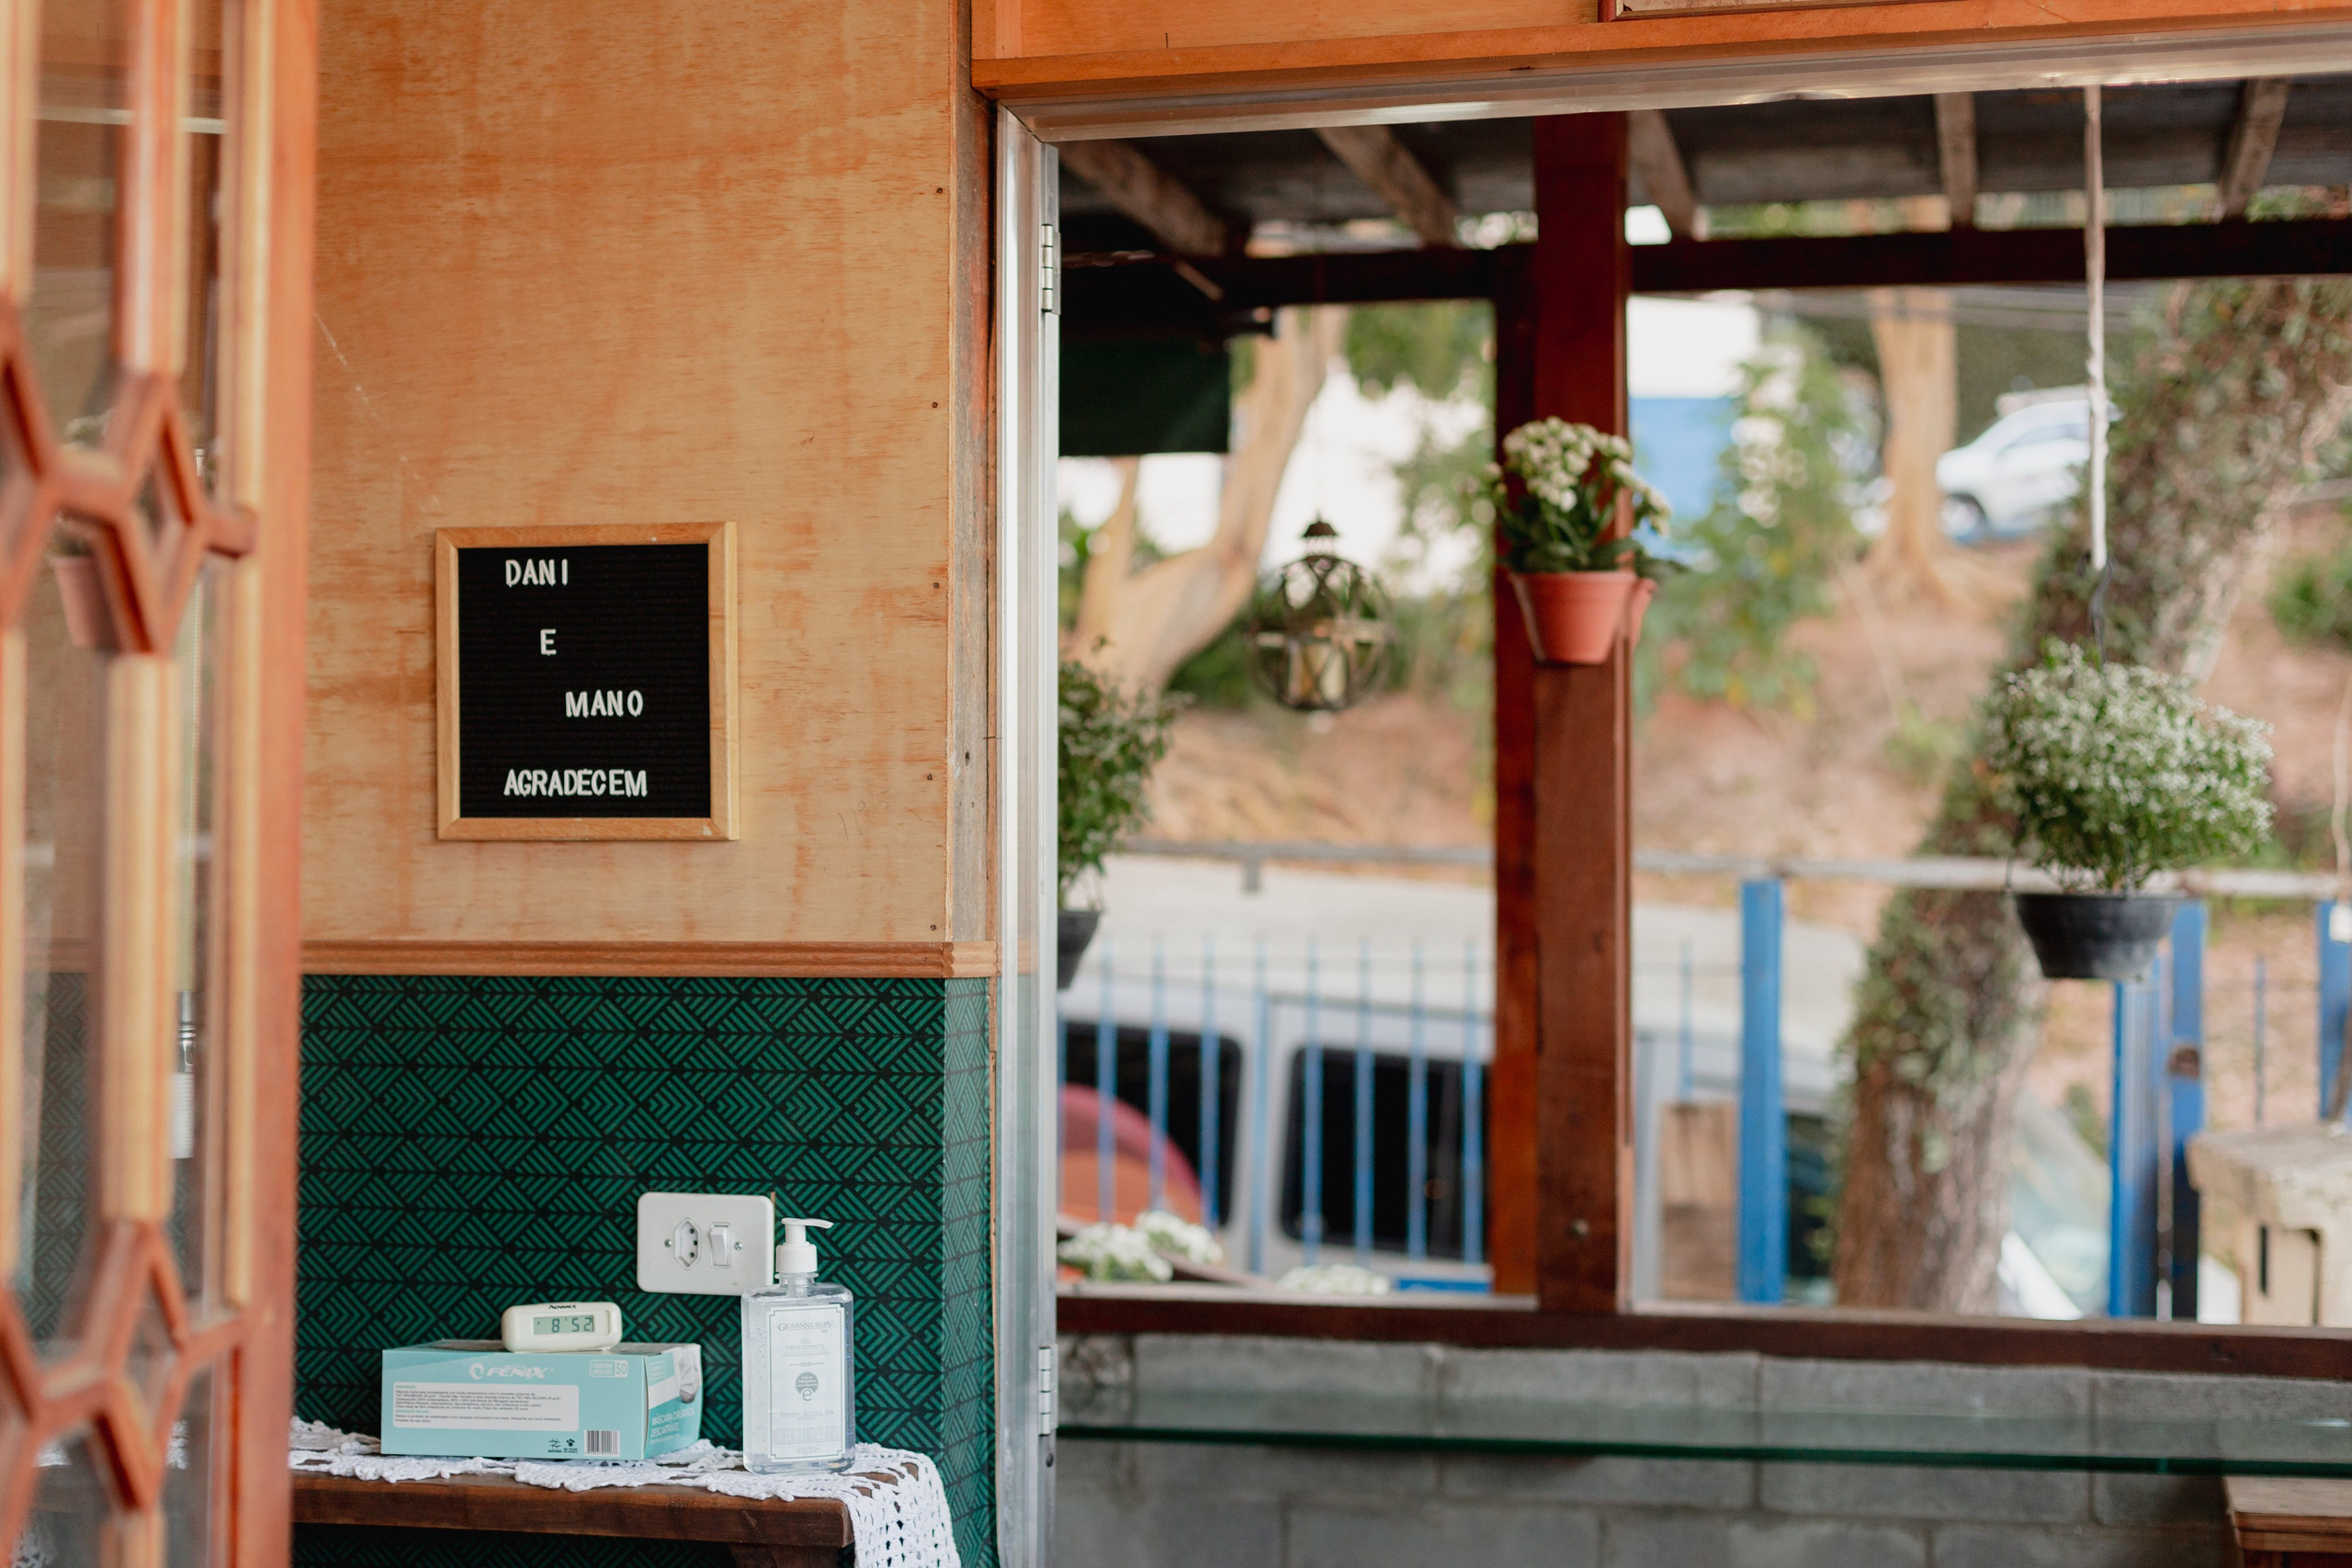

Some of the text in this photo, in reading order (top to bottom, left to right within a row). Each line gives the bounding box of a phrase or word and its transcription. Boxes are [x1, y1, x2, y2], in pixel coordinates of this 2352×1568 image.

[505, 558, 569, 588] DANI
[540, 629, 557, 656] E
[565, 690, 644, 718] MANO
[503, 769, 648, 797] AGRADECEM
[616, 1362, 628, 1375] 50
